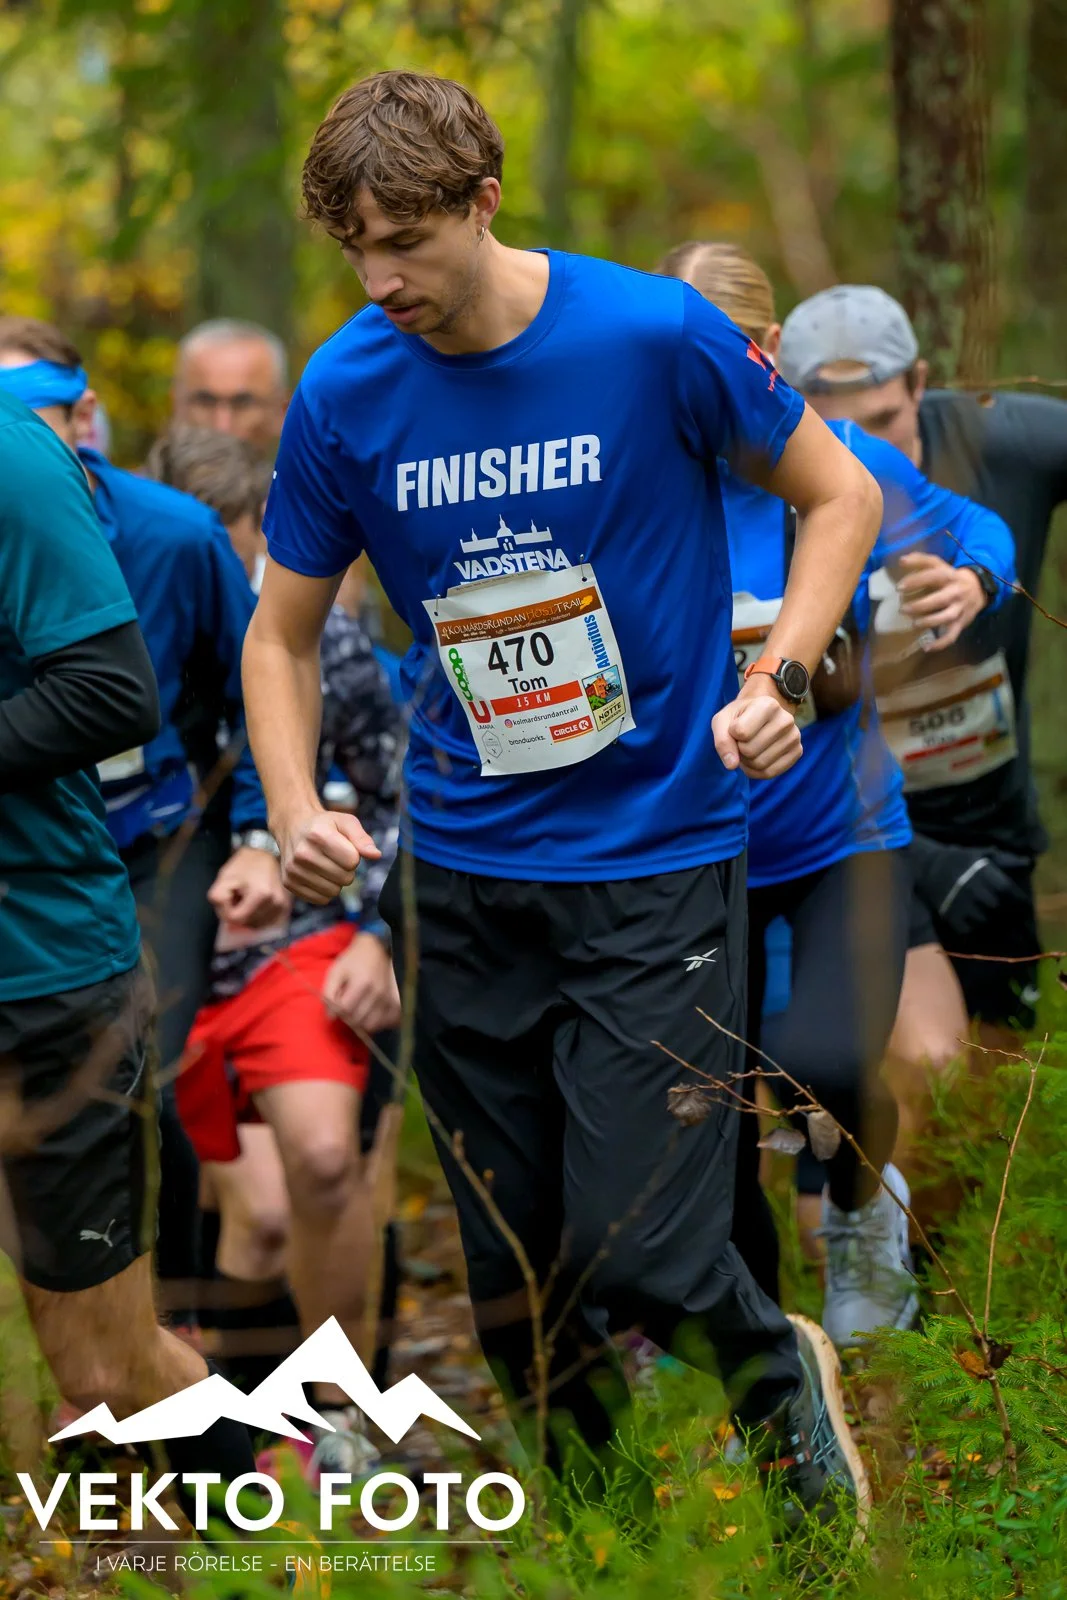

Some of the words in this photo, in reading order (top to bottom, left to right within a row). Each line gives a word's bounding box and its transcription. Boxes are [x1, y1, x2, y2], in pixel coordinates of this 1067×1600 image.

[397, 434, 602, 512] FINISHER
[453, 548, 573, 580] VADSTENA
[488, 631, 554, 675] 470
[584, 614, 611, 669] Aktivitus
[448, 648, 474, 701] coop
[508, 675, 548, 694] Tom
[512, 705, 579, 726] kolmardsrundantrail
[516, 696, 530, 708] 15
[535, 692, 551, 704] KM
[553, 724, 579, 737] CIRCLE
